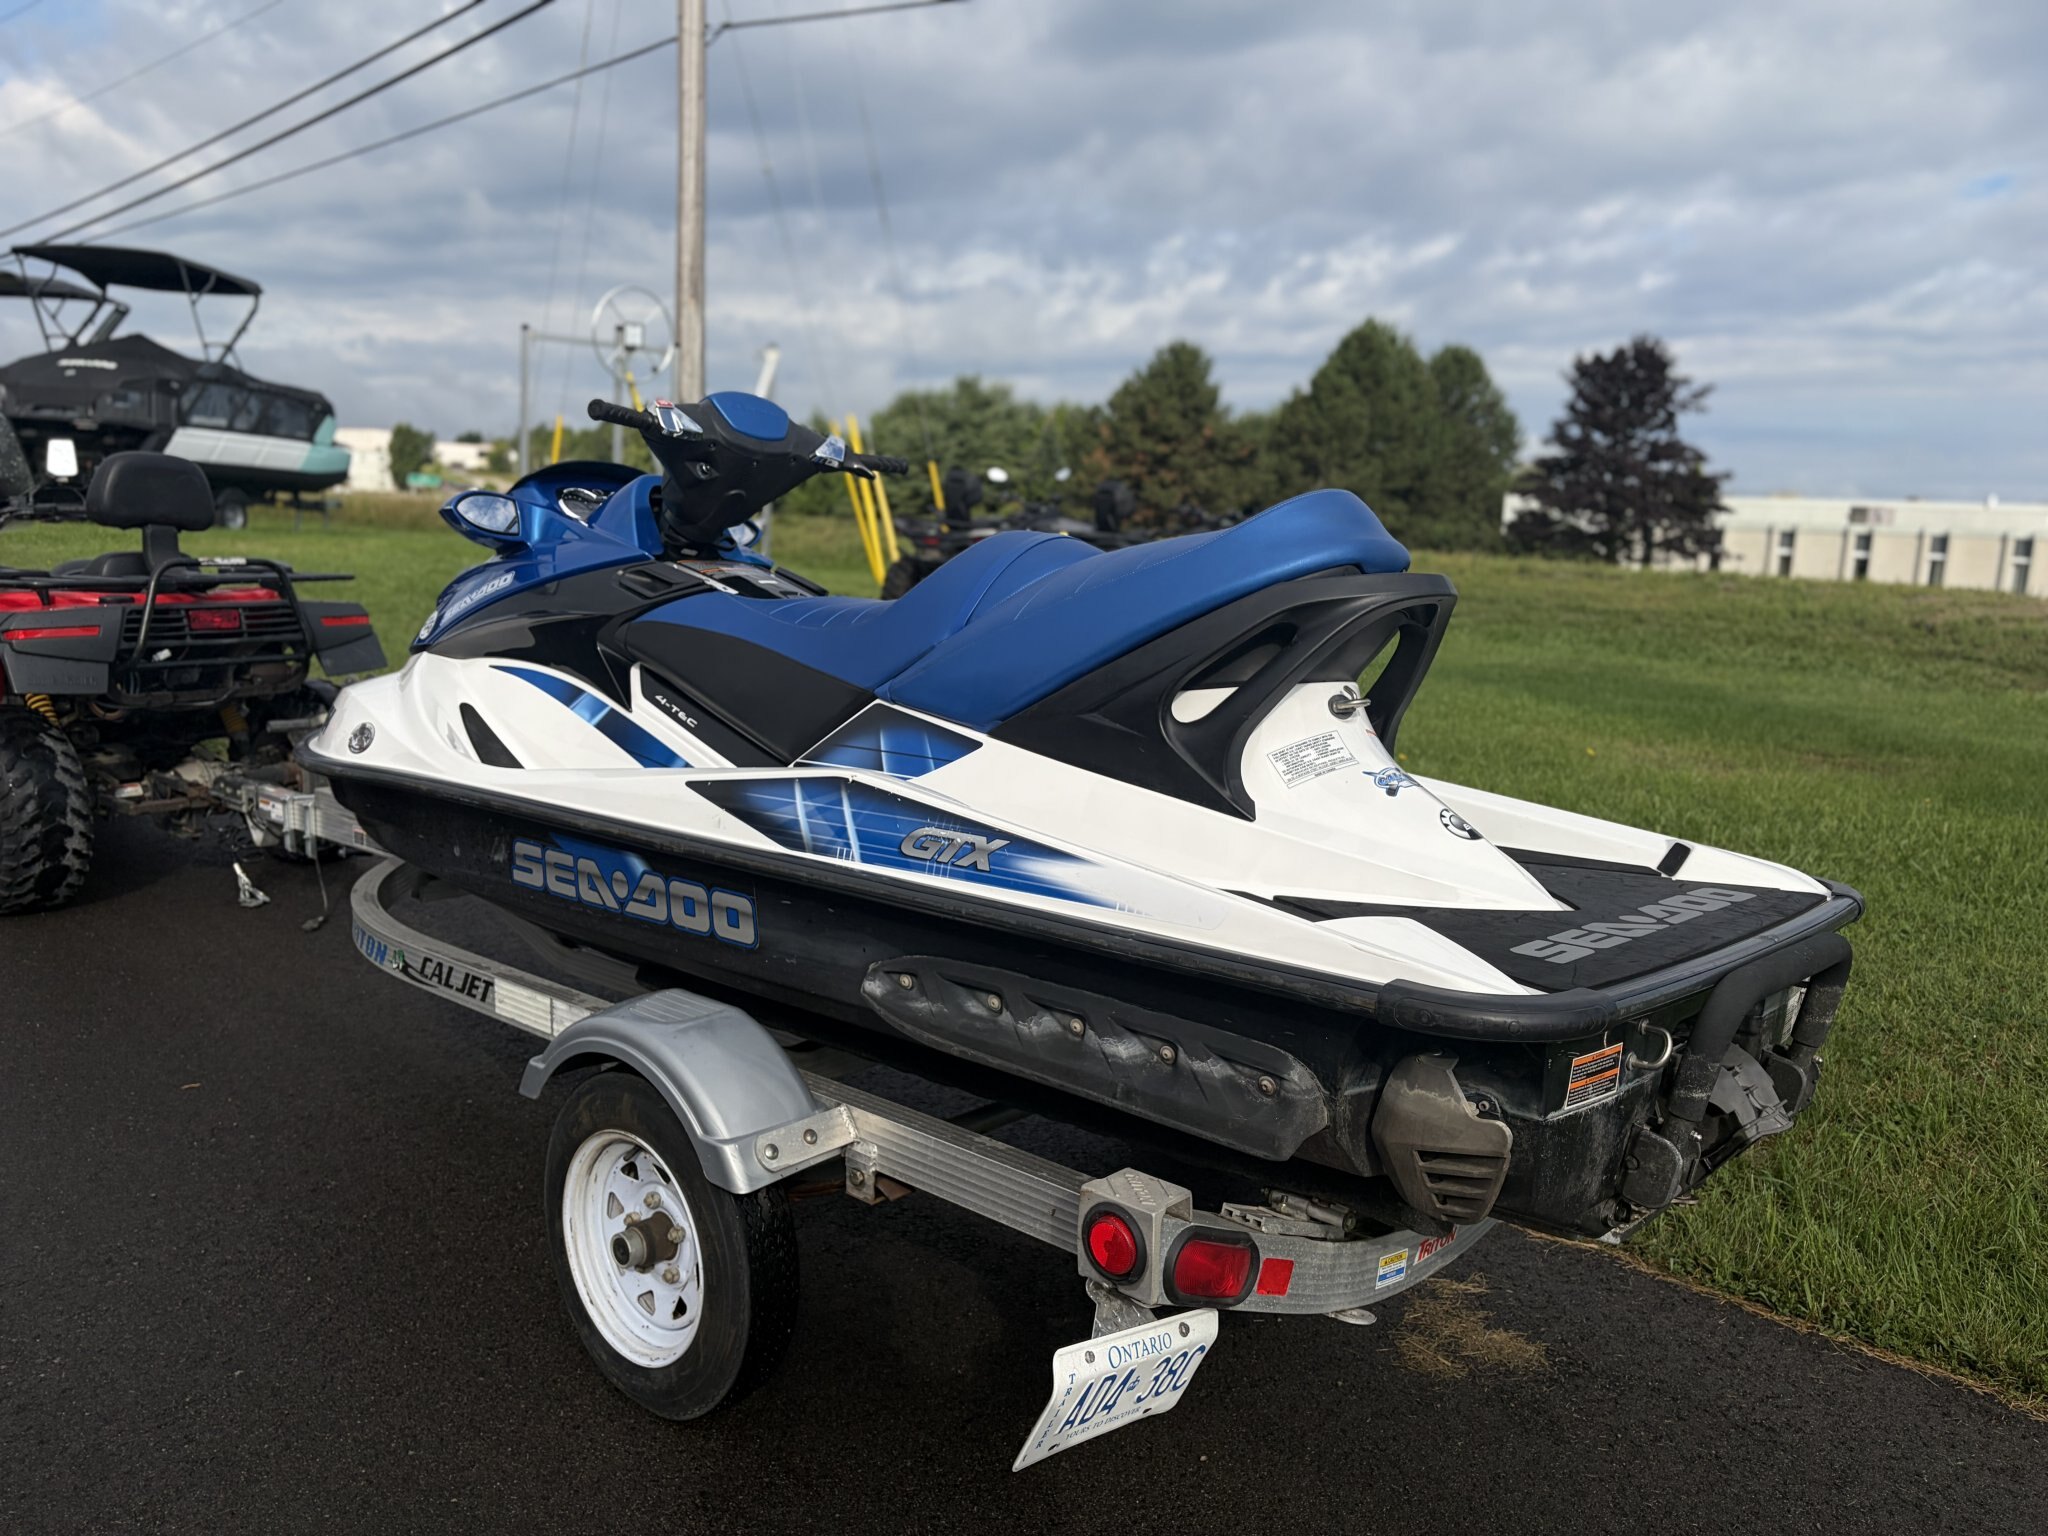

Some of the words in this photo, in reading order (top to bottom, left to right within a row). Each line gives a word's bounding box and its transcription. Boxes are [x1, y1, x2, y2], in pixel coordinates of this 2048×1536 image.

[901, 825, 1010, 872] GTX
[1417, 1225, 1457, 1262] TRITON
[1108, 1332, 1173, 1369] ONTARIO
